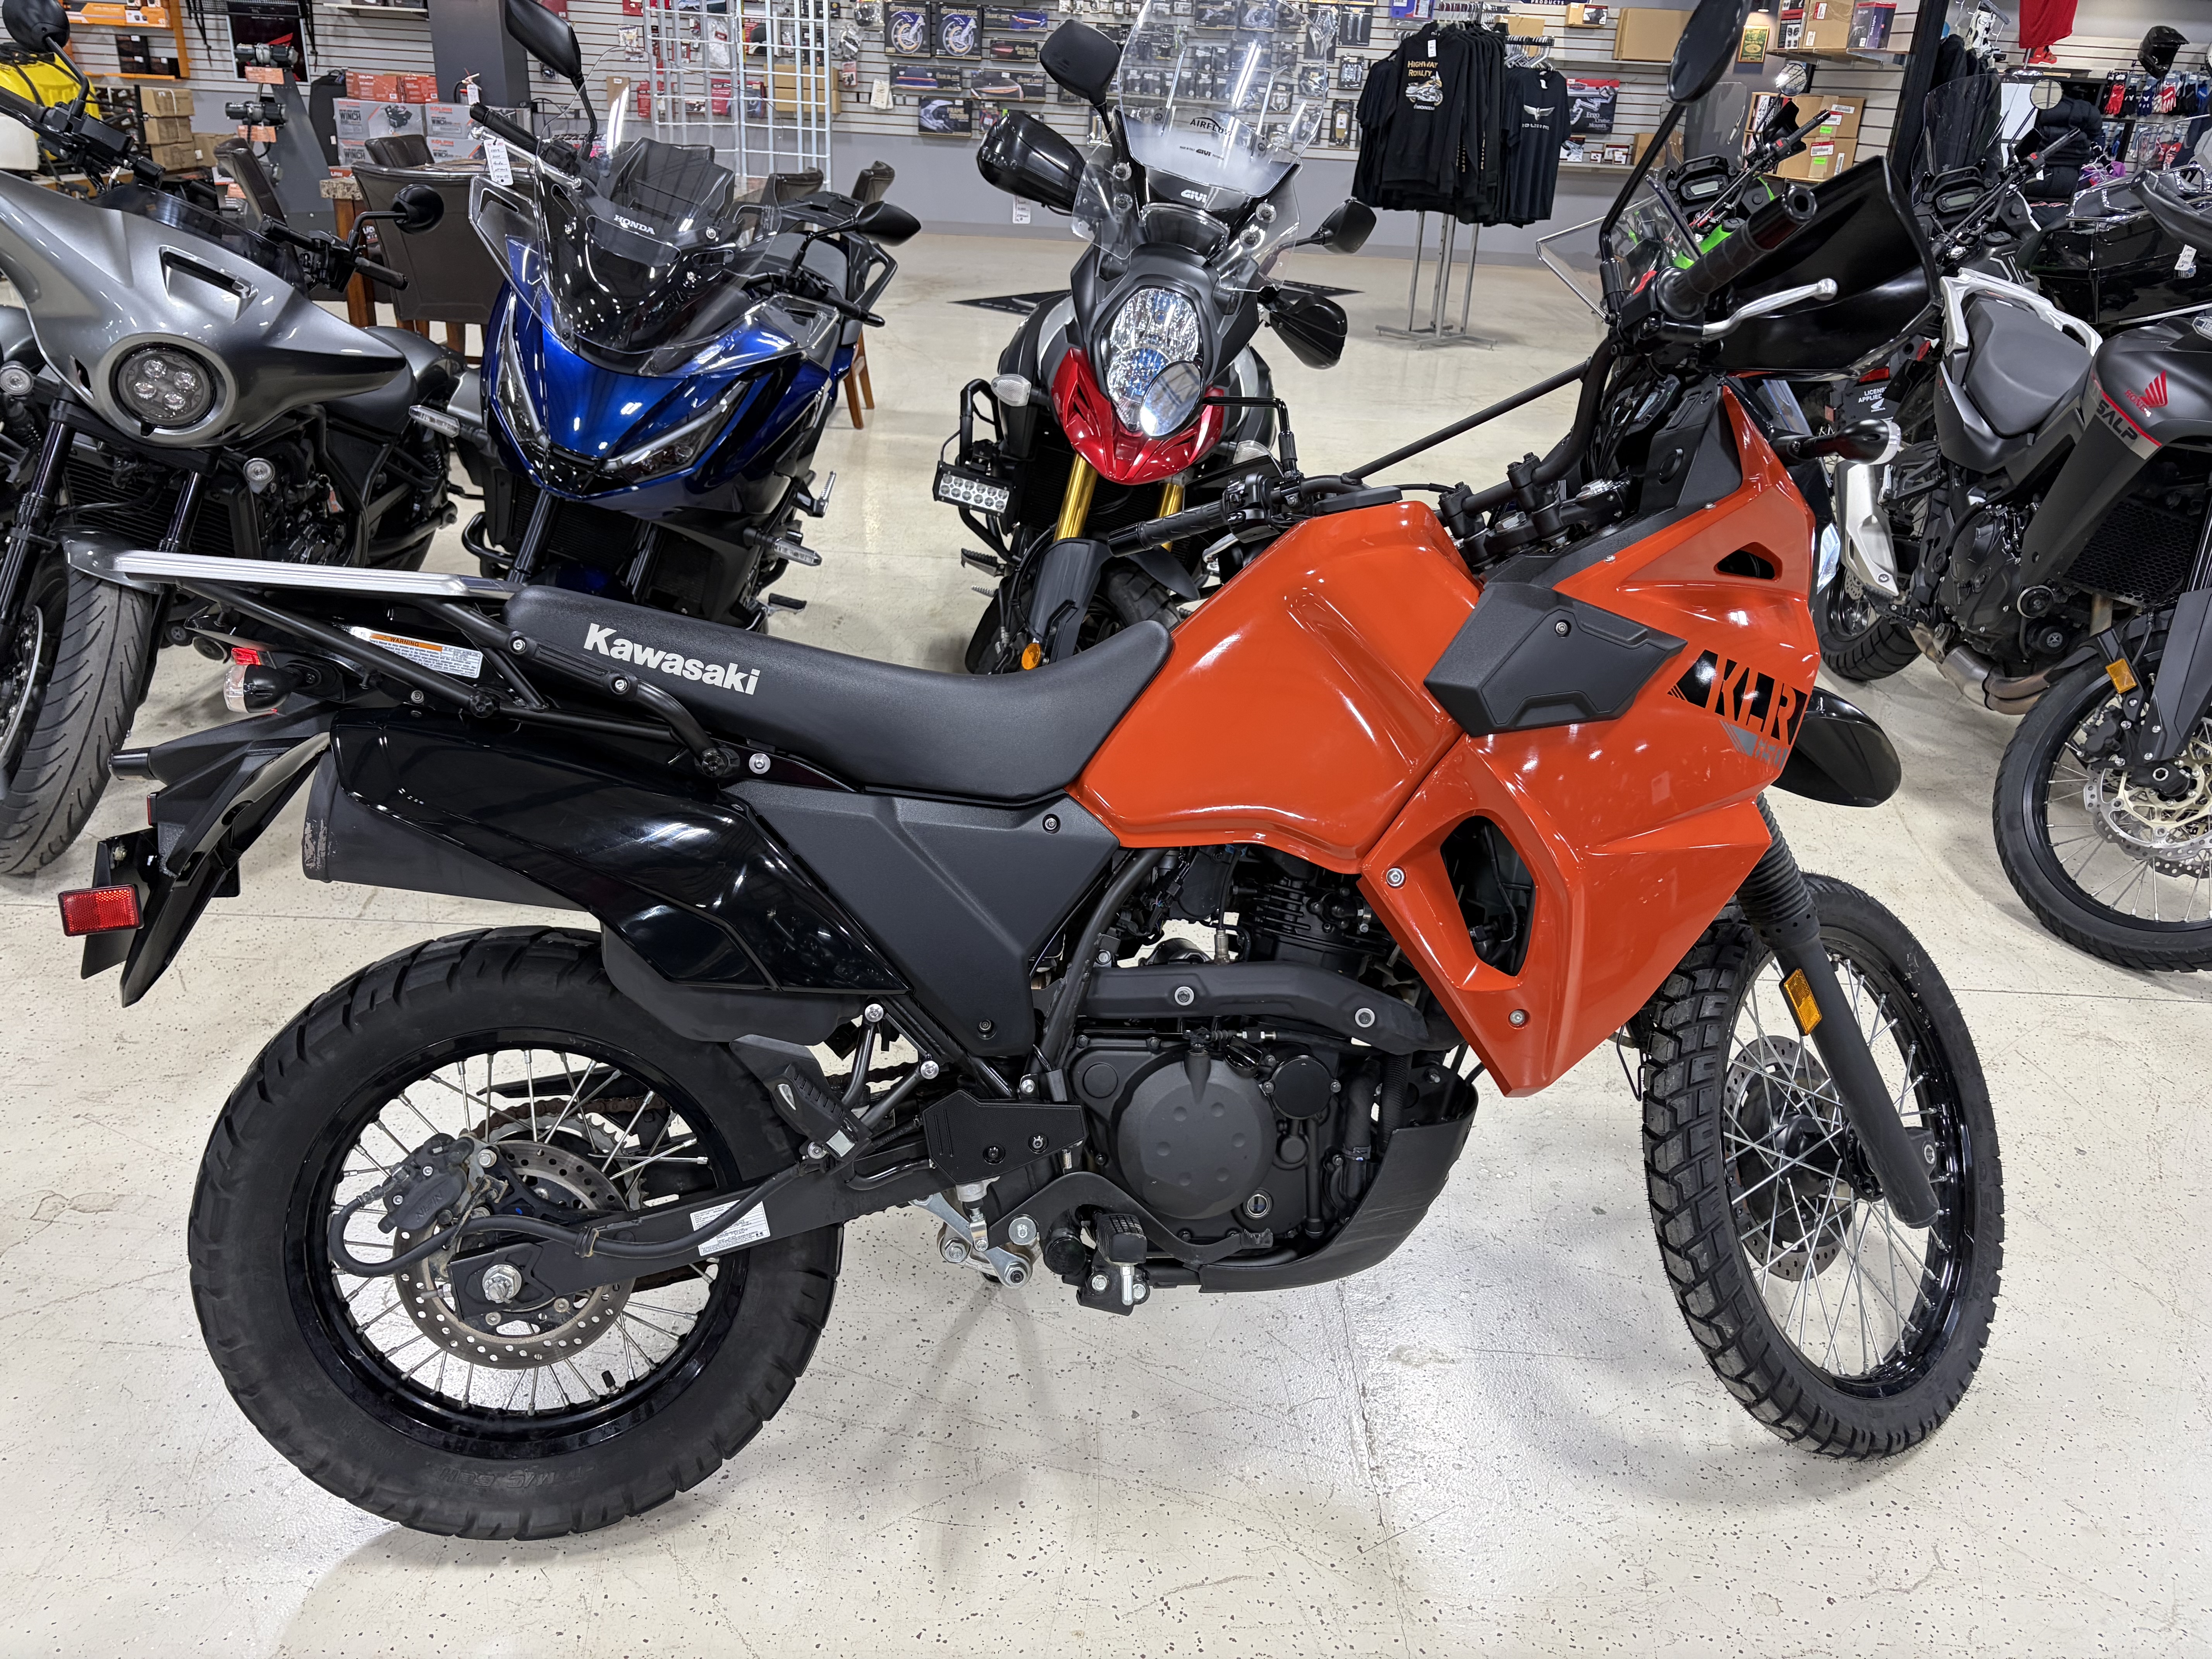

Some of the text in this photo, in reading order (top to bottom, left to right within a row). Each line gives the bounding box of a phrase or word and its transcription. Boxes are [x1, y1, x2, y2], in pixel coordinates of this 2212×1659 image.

[1407, 60, 1438, 69] HIGHWAY
[339, 112, 361, 121] WINCH
[344, 152, 366, 160] WINCH
[1181, 189, 1207, 203] GIVI
[614, 215, 655, 235] HONDA
[1864, 386, 1887, 396] LICENS
[2125, 388, 2152, 417] HOND
[390, 636, 419, 647] WARNING
[584, 623, 760, 695] Kawasaki
[1705, 654, 1796, 746] KLR
